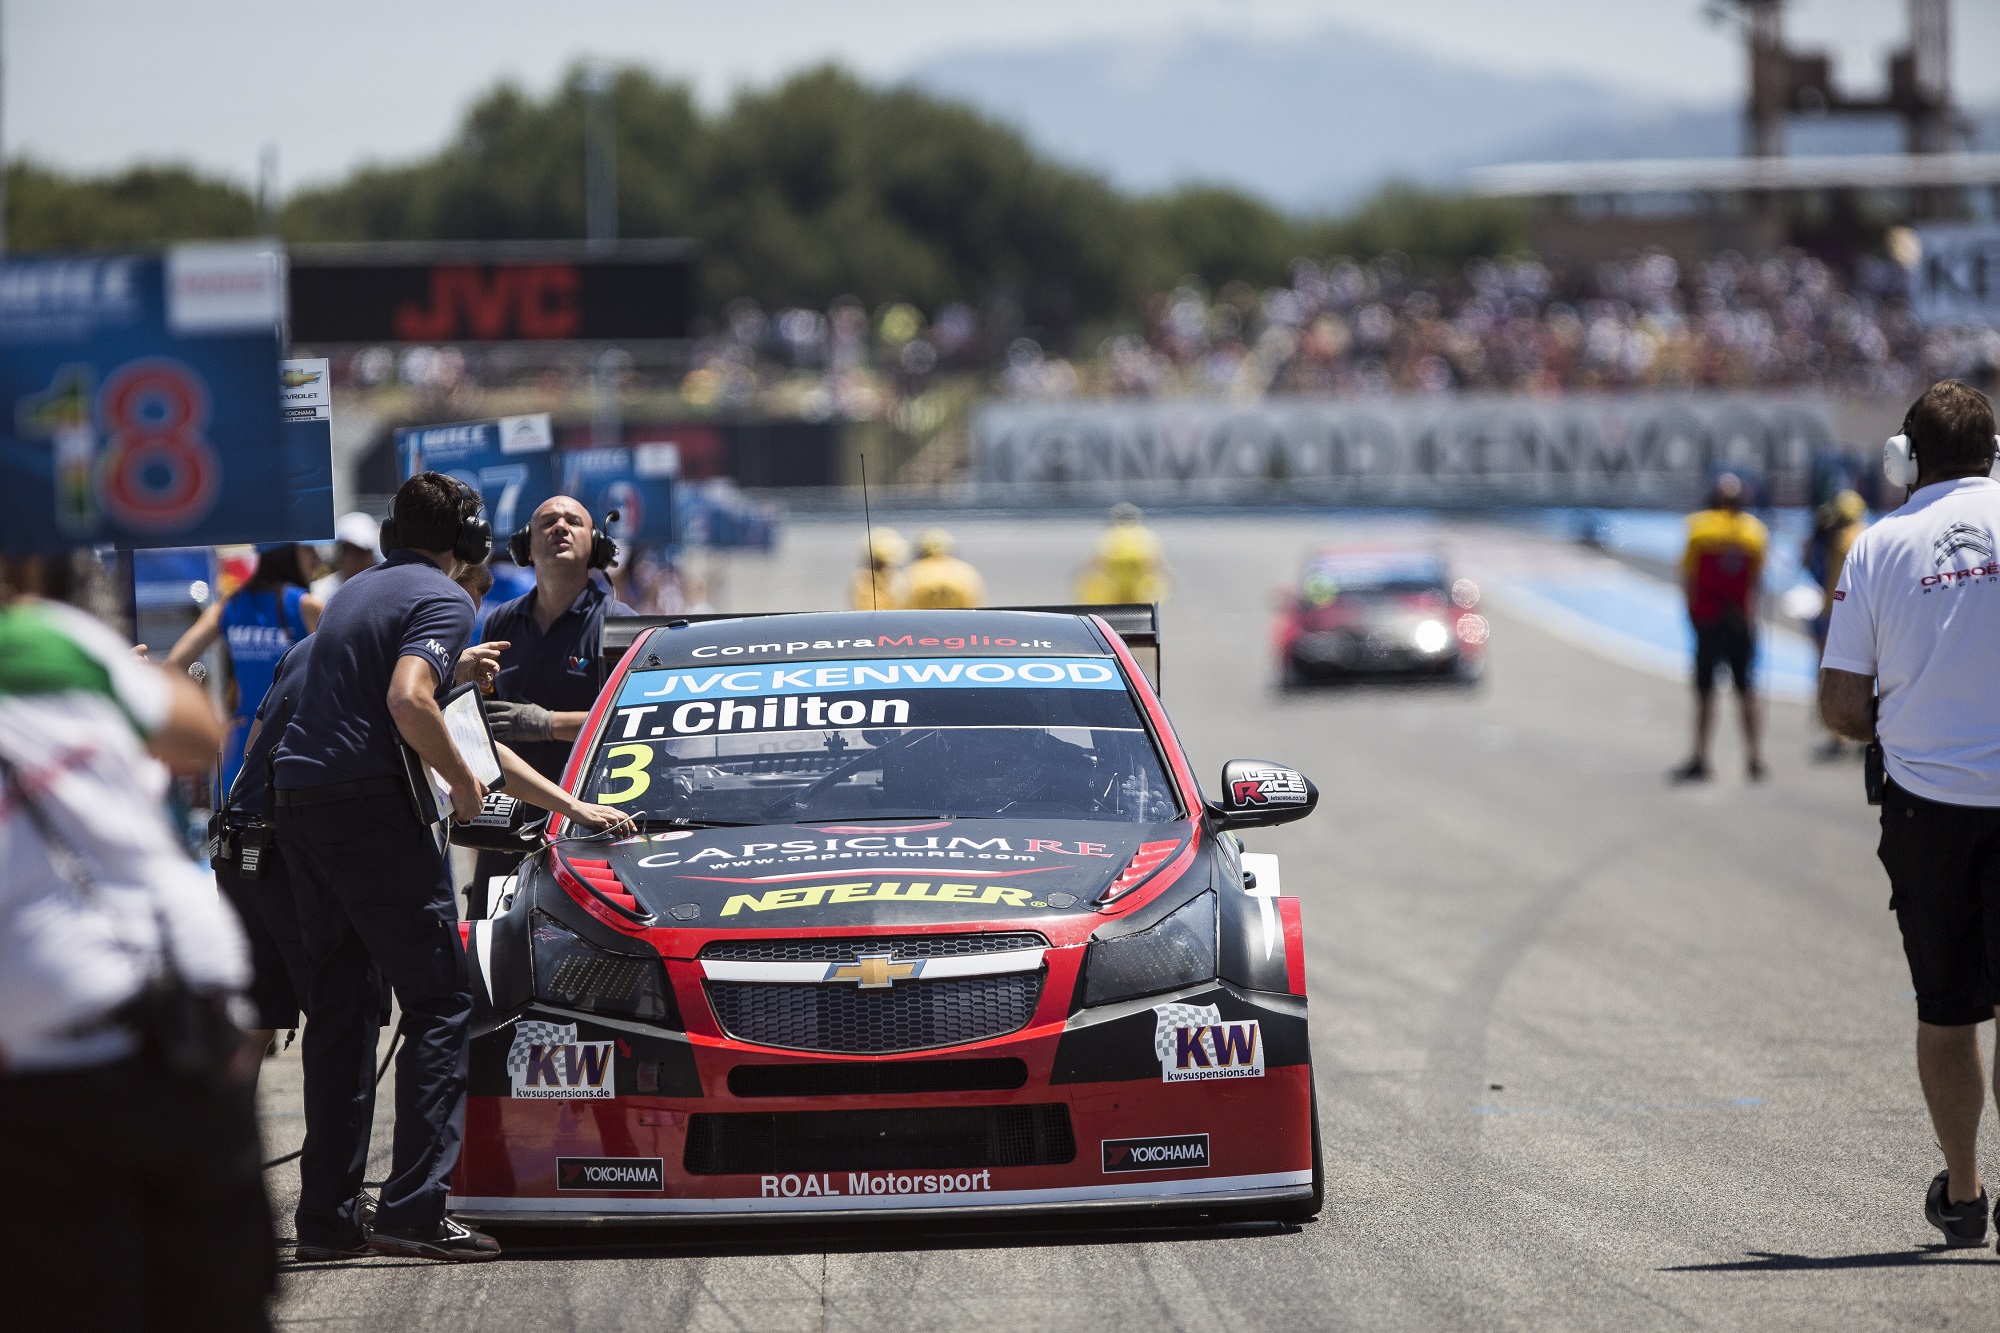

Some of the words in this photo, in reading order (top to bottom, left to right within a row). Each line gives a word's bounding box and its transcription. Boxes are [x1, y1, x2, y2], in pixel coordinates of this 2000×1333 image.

[393, 263, 584, 340] JVC
[280, 392, 318, 400] EVROLET
[16, 358, 221, 536] 18
[1921, 561, 2000, 587] CITROË
[617, 696, 910, 739] T.Chilton
[597, 744, 654, 805] 3
[1233, 780, 1305, 804] RACE
[481, 803, 512, 816] CE
[637, 837, 1013, 867] CAPSICUM
[1023, 838, 1115, 858] RE
[709, 850, 1036, 870] www.capsicumRE.com
[1175, 1024, 1258, 1070] KW
[525, 1044, 613, 1087] KW
[1167, 1066, 1261, 1081] kwsuspensions.de
[516, 1087, 610, 1098] kwsuspensions.de
[1130, 1143, 1205, 1162] YOKOHAMA
[583, 1166, 659, 1182] YOKOHAMA
[760, 1174, 840, 1197] ROAL
[848, 1169, 991, 1195] Motorsport
